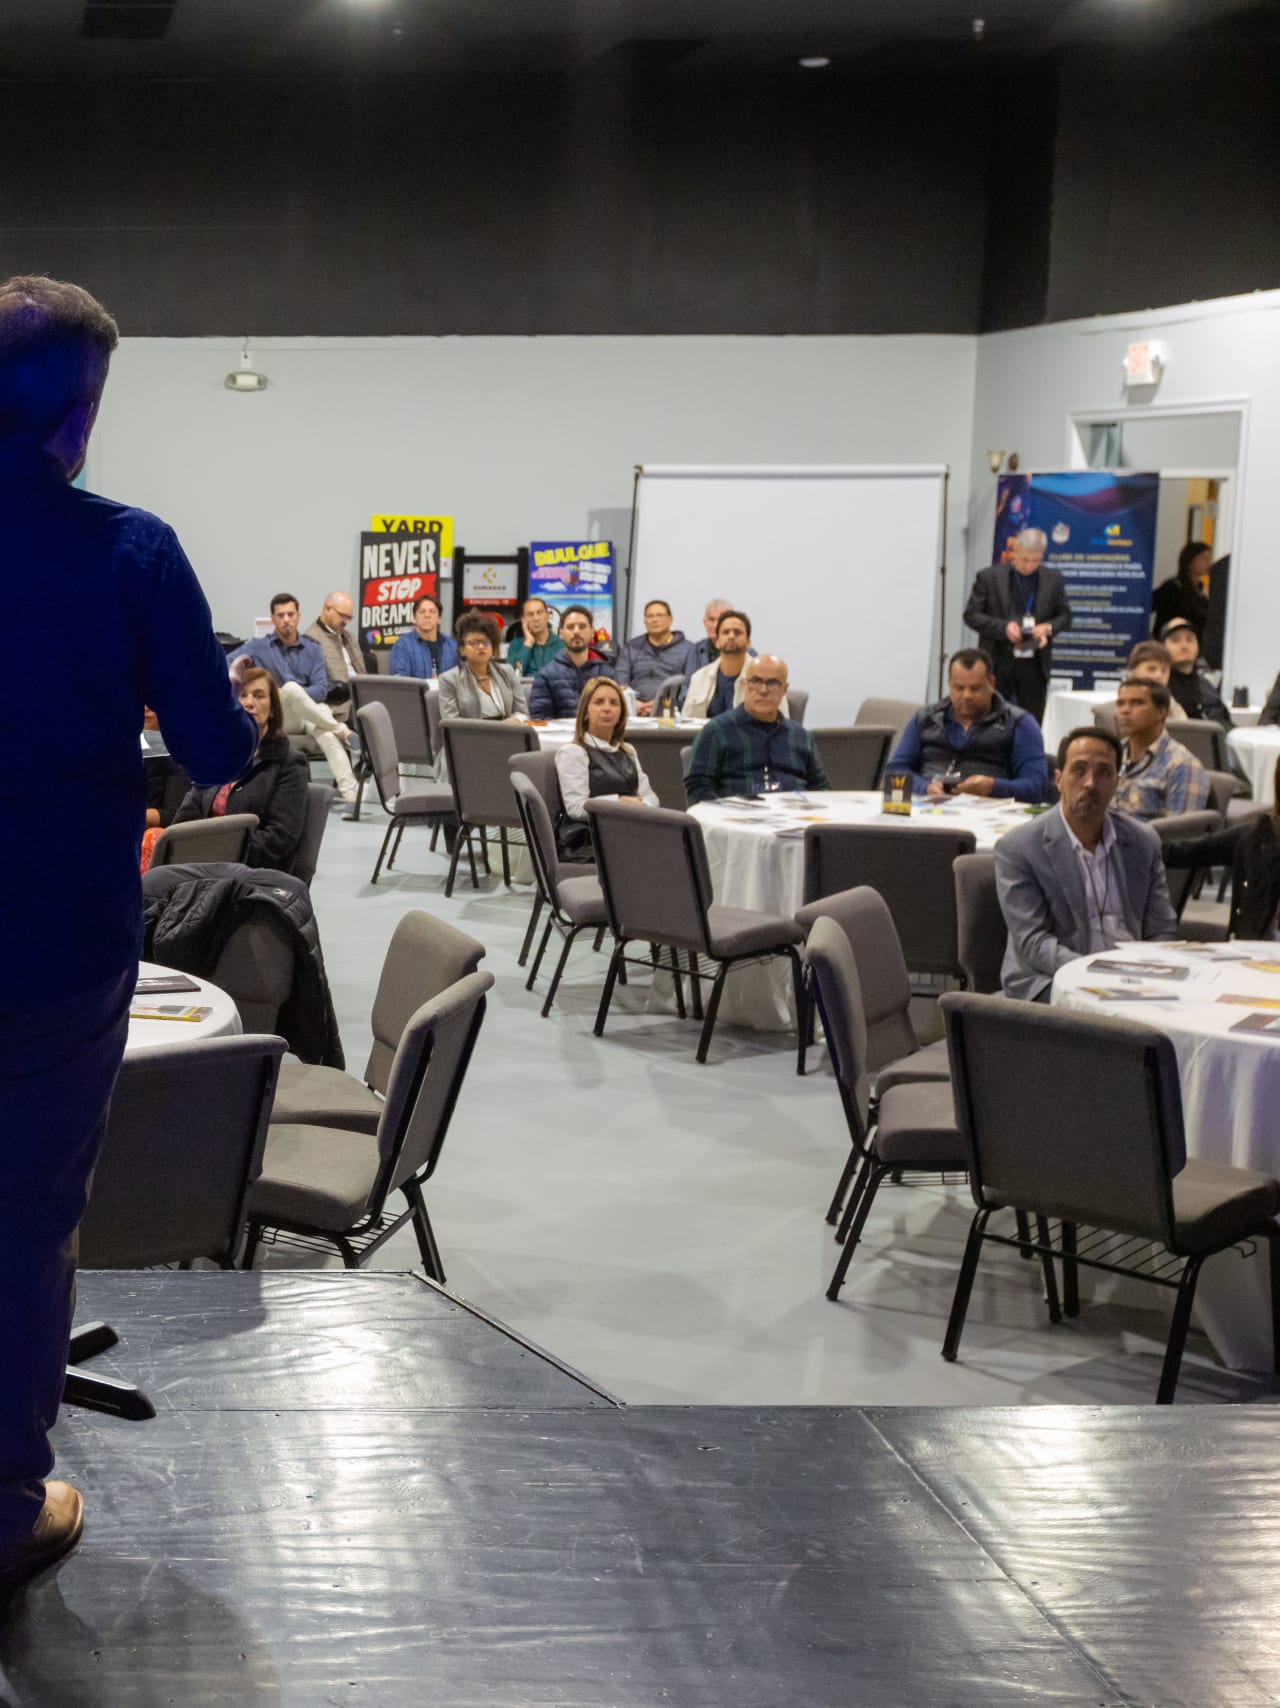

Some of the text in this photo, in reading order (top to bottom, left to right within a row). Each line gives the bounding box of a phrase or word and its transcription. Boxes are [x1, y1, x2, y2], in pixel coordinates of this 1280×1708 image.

[382, 518, 443, 534] YARD
[363, 538, 436, 579] NEVER
[377, 577, 422, 603] STOP
[361, 602, 415, 628] DREAM
